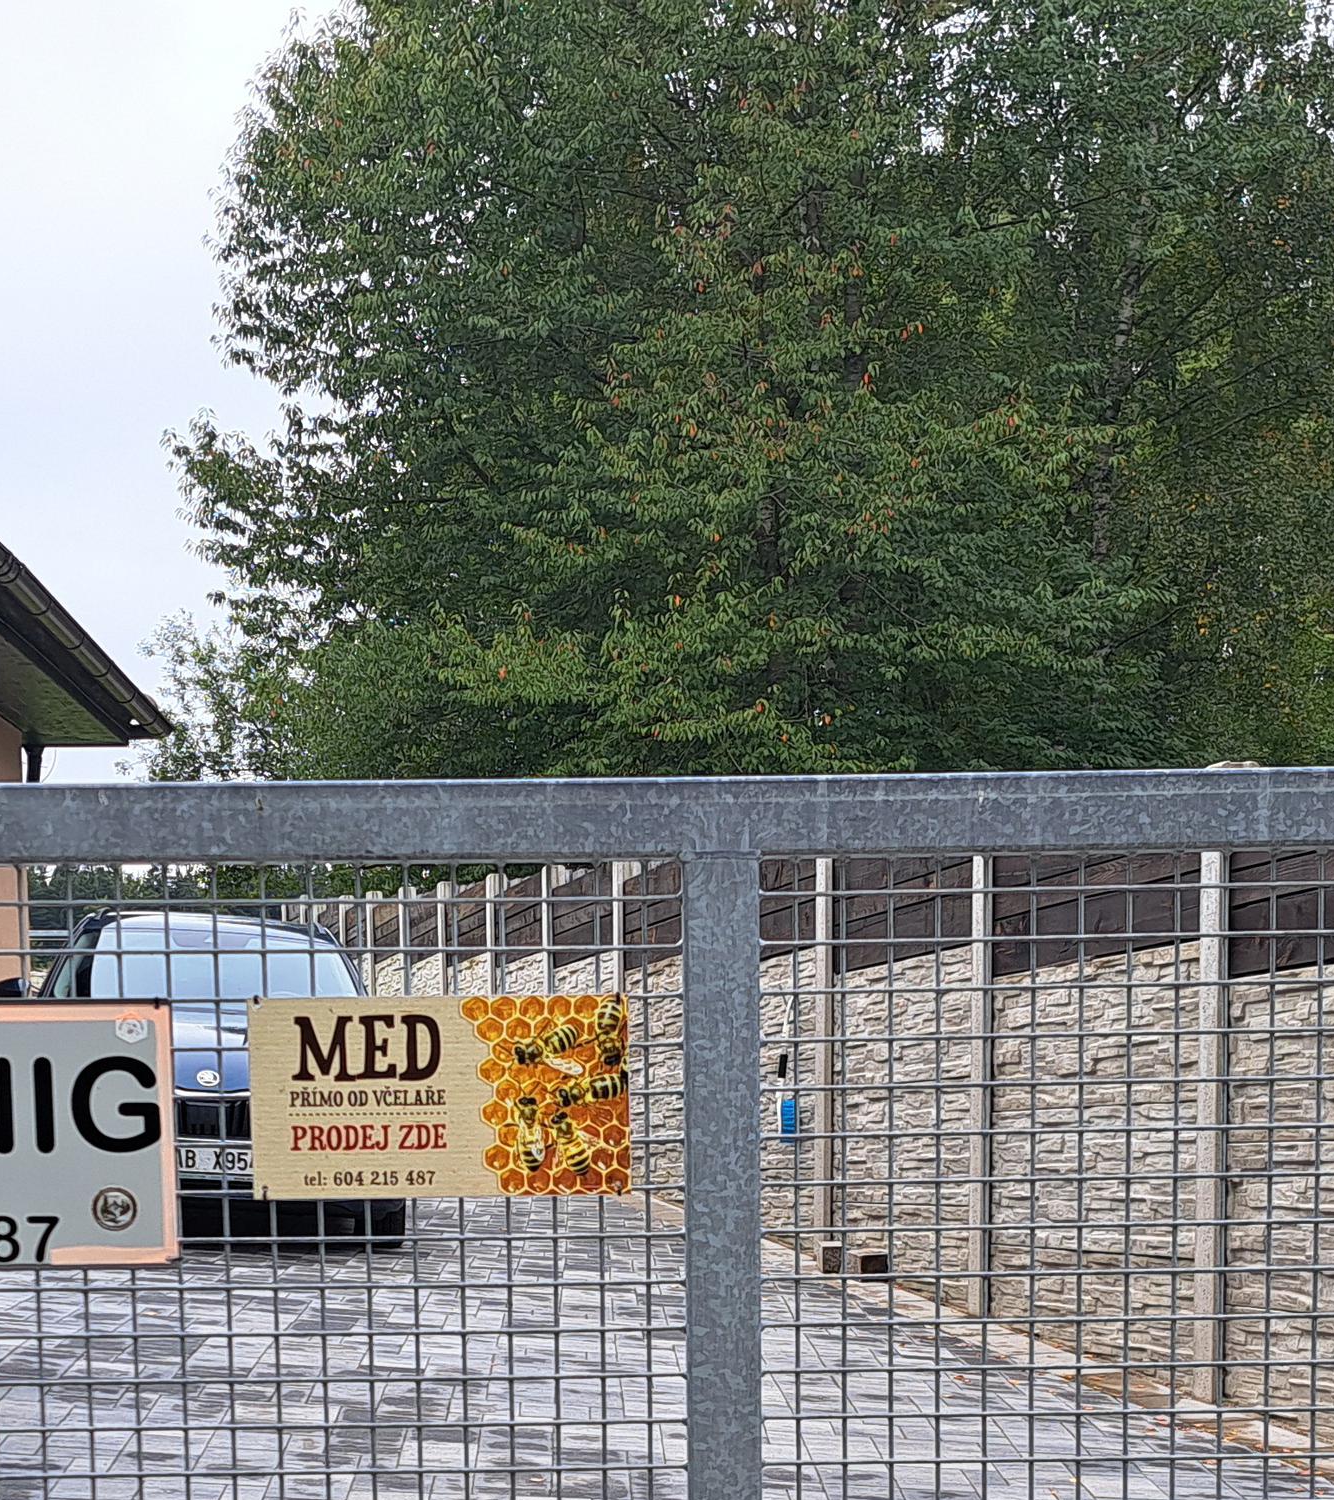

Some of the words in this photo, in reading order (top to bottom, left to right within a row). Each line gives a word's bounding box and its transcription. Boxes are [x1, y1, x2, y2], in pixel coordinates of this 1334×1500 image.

[291, 1014, 442, 1082] MED
[289, 1086, 344, 1107] PŘÍMO
[347, 1090, 369, 1107] OD
[372, 1085, 446, 1107] VČELAŘE
[290, 1124, 391, 1151] PRODEJ
[398, 1124, 447, 1150] ZDE
[304, 1171, 328, 1186] tel:
[333, 1171, 364, 1186] 604
[370, 1170, 399, 1186] 215
[405, 1170, 436, 1186] 487
